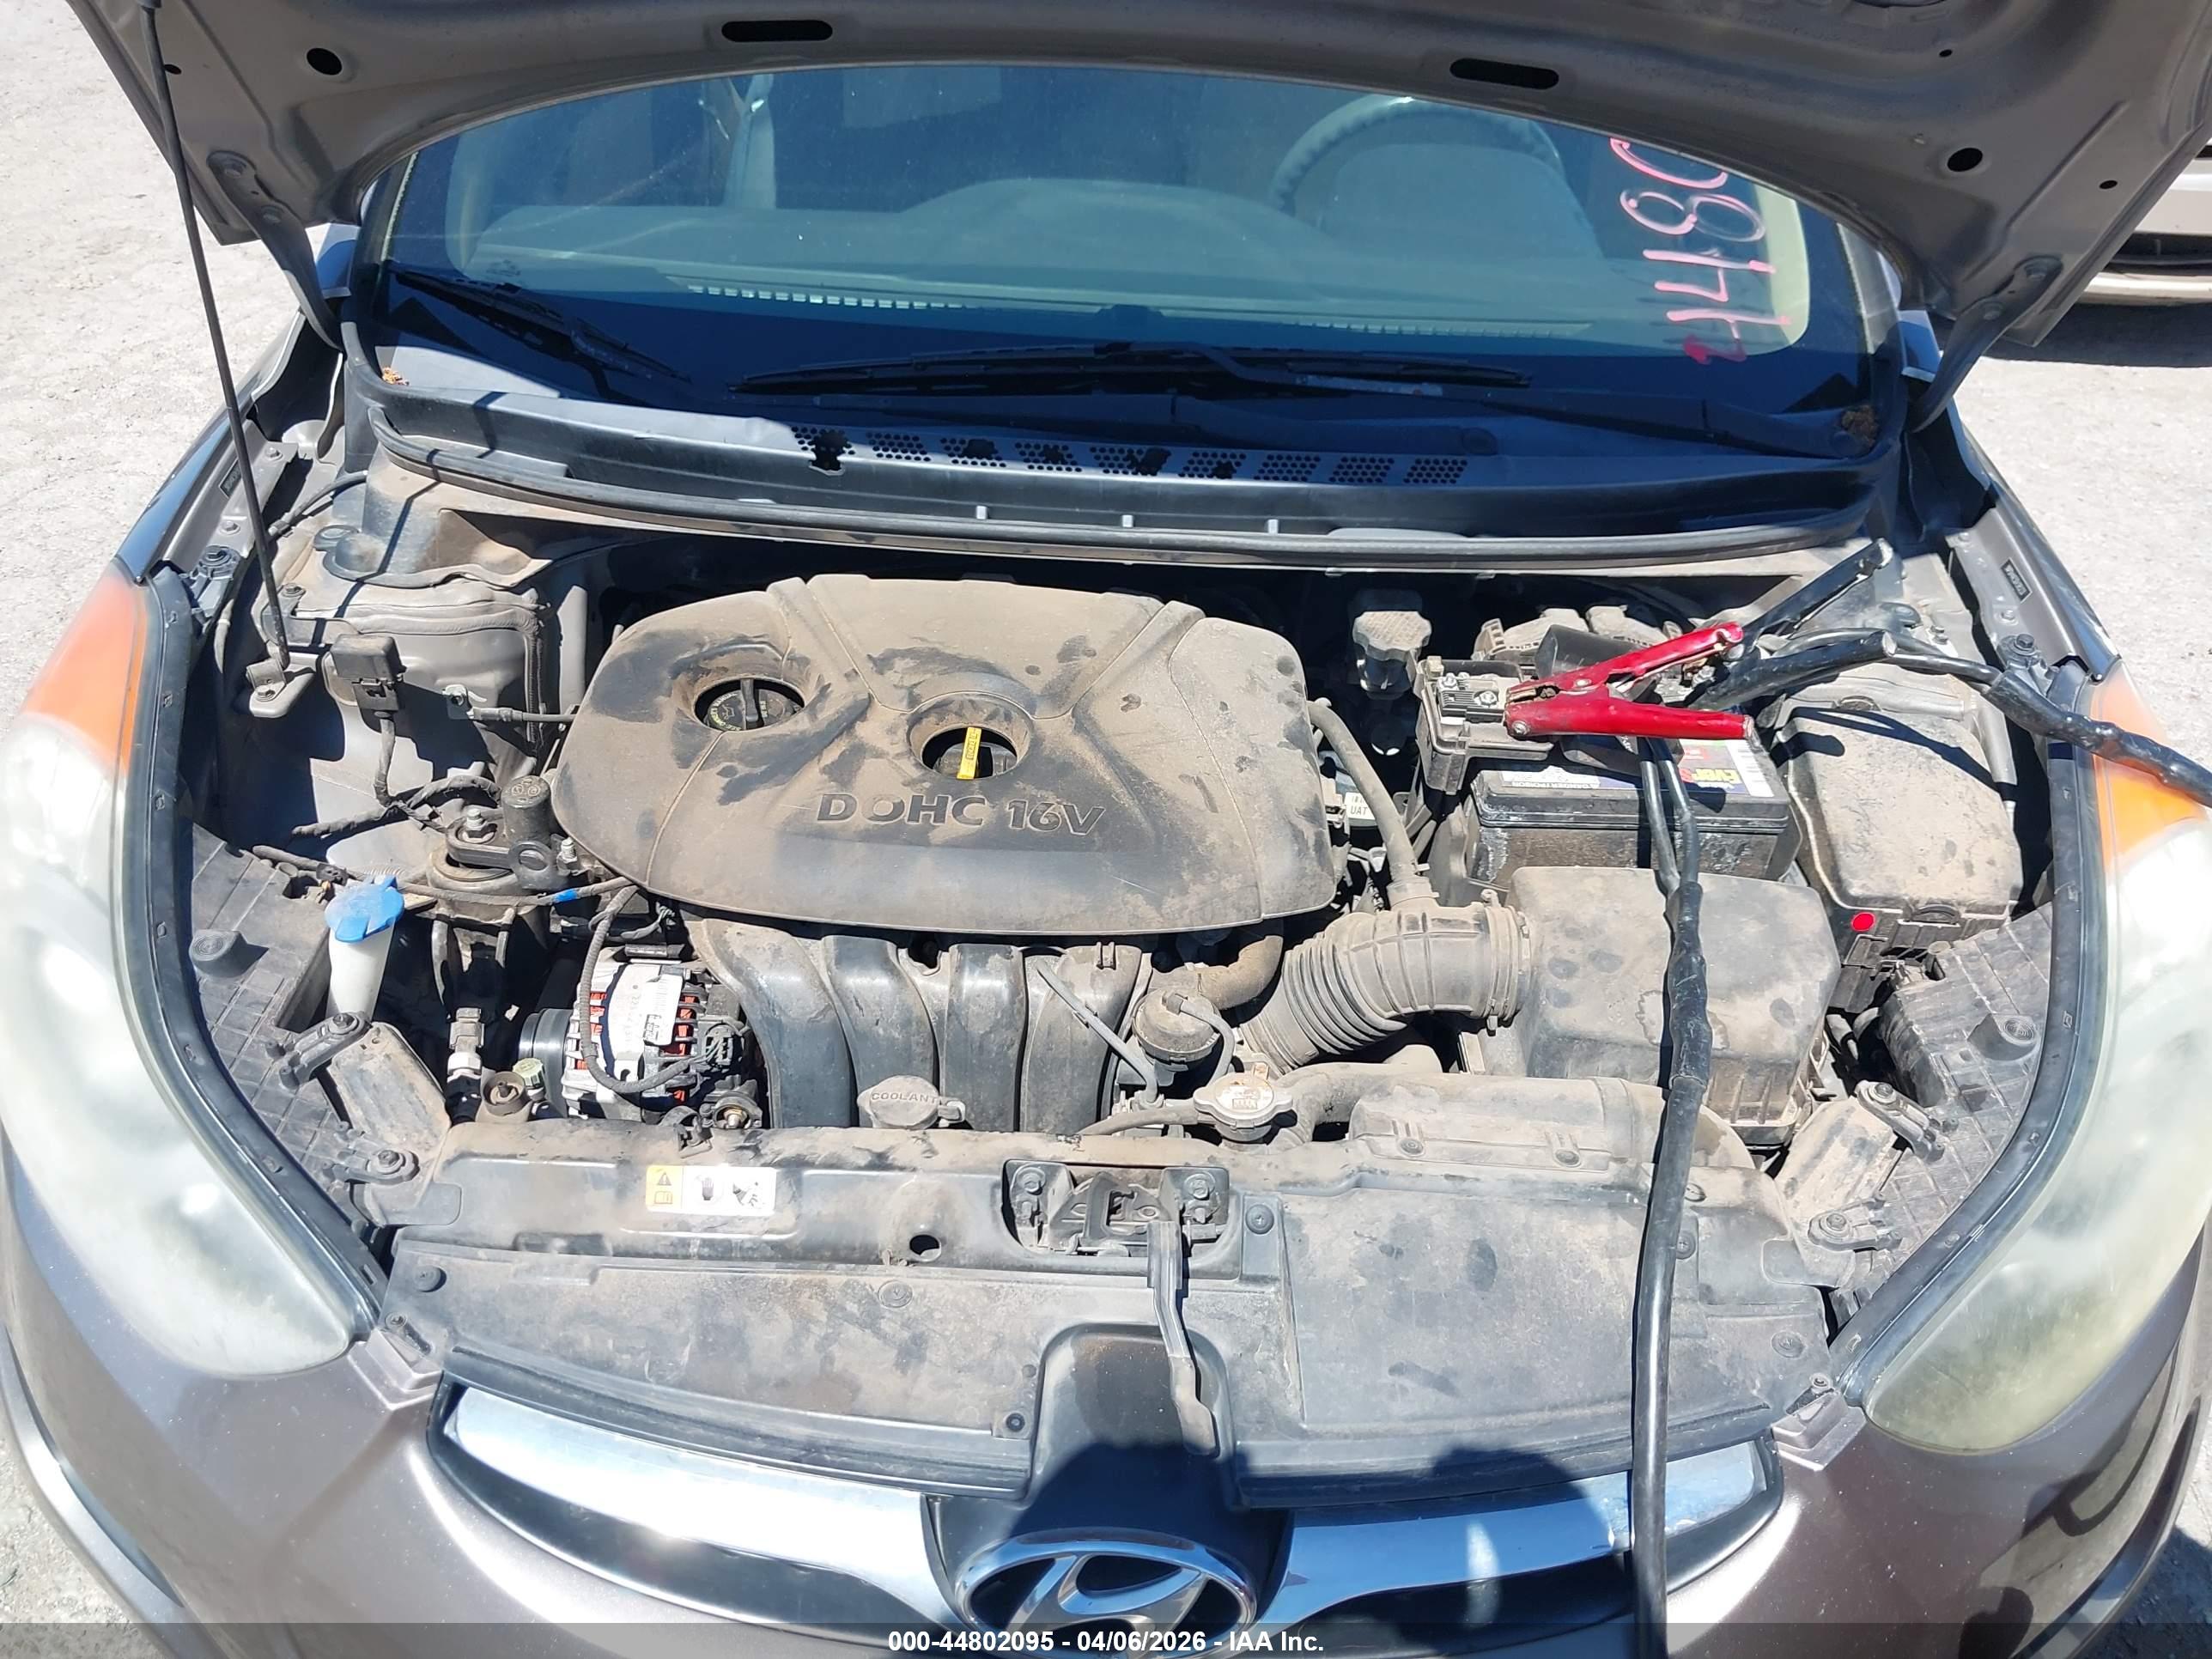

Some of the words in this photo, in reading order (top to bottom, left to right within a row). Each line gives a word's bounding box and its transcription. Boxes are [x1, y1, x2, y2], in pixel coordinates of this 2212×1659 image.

[817, 793, 989, 827] DOHC
[1007, 799, 1106, 836] 16V
[1350, 805, 1368, 816] UAT
[872, 1091, 939, 1105] COOLANT
